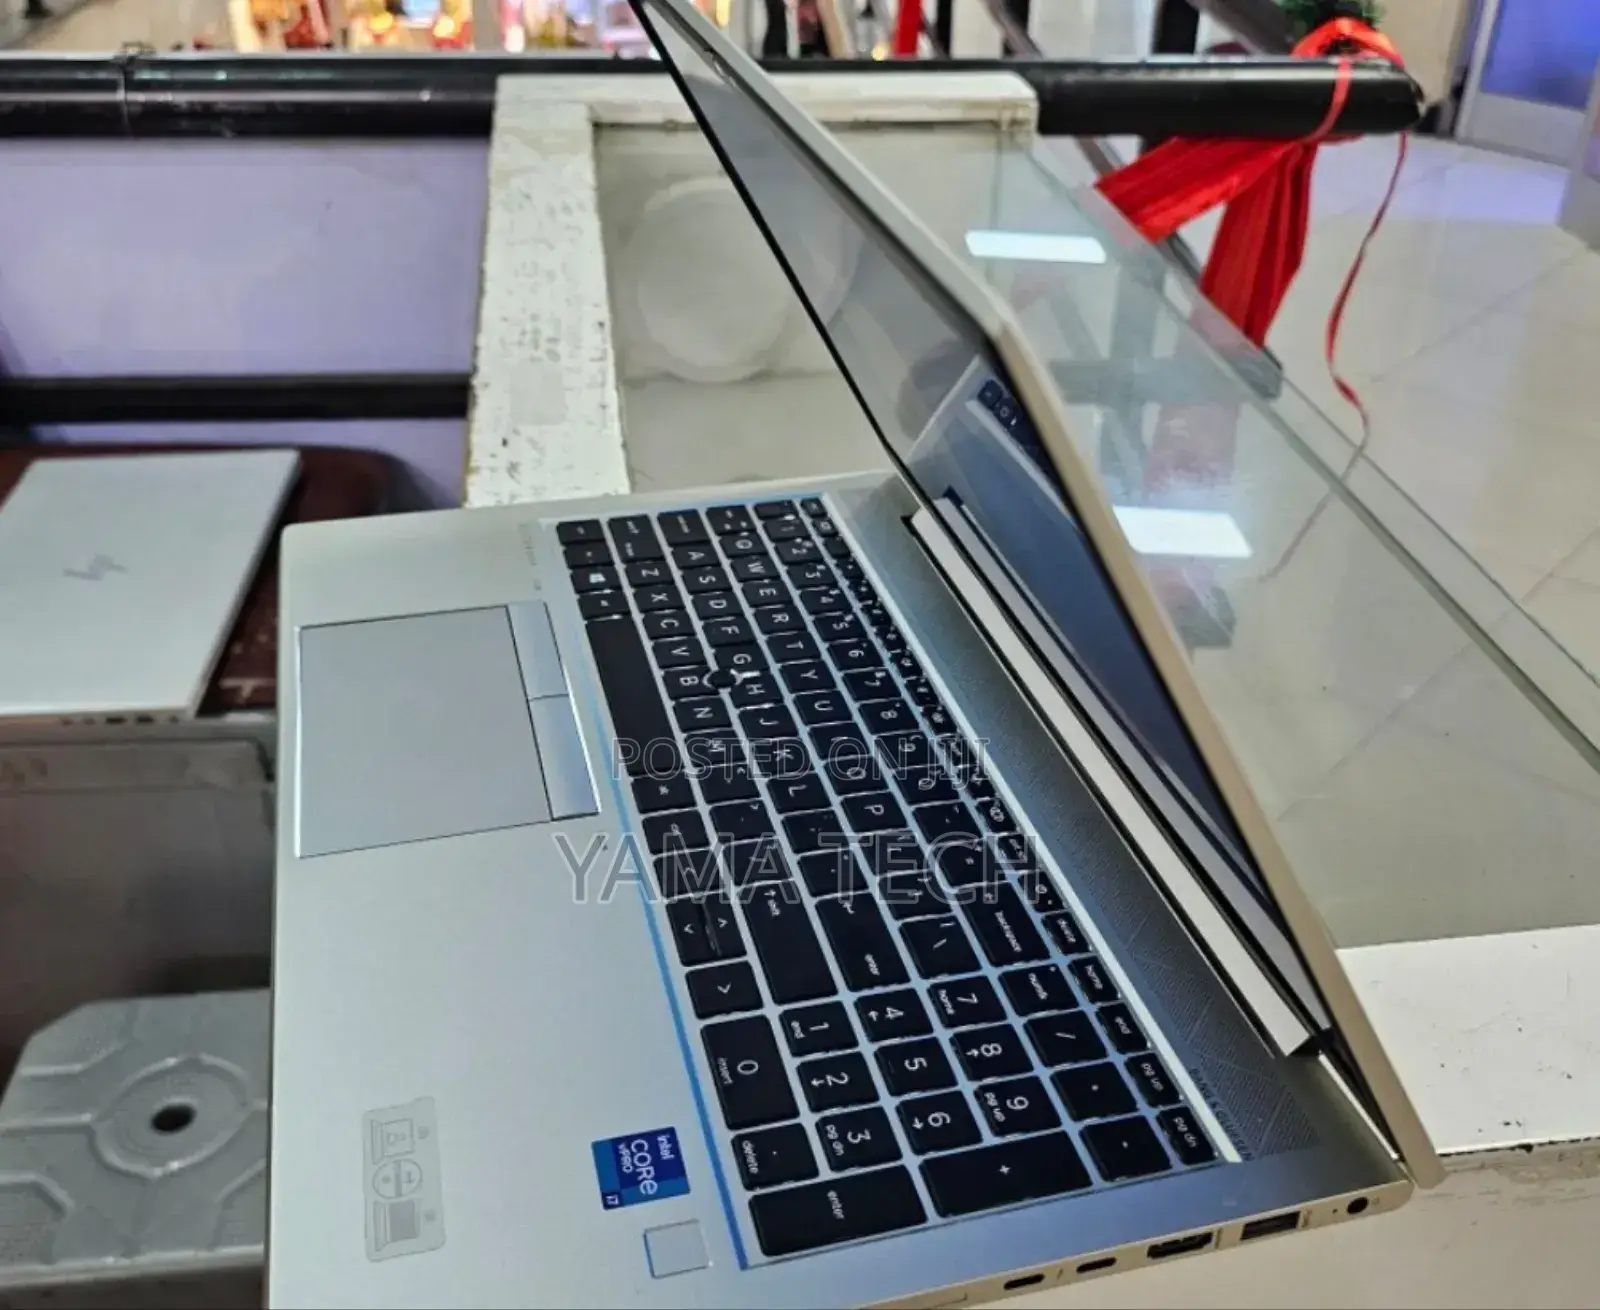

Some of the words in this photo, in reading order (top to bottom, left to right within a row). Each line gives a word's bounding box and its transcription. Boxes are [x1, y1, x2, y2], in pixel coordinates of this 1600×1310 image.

[688, 551, 704, 560] A
[642, 568, 660, 577] Z
[748, 562, 765, 574] W
[700, 575, 716, 584] S
[651, 592, 668, 602] X
[759, 588, 776, 596] E
[708, 599, 726, 608] D
[660, 619, 679, 628] C
[772, 613, 789, 623] R
[721, 625, 740, 634] F
[832, 622, 850, 630] 5
[786, 640, 804, 650] T
[671, 646, 690, 657] V
[848, 649, 864, 658] 6
[733, 653, 751, 664] G
[801, 669, 818, 679] Y
[679, 676, 699, 686] B
[864, 679, 882, 687] 7
[746, 683, 766, 695] H
[814, 700, 834, 711] U
[693, 707, 714, 719] N
[880, 710, 898, 720] 8
[900, 742, 916, 752] 9
[773, 749, 794, 761] K
[846, 767, 866, 780] O
[788, 784, 807, 797] L
[863, 804, 885, 816] P
[956, 993, 978, 1004] 7
[885, 1006, 904, 1021] 4
[809, 1022, 830, 1032] 1
[980, 1042, 1003, 1058] 8
[736, 1059, 759, 1076] 0
[904, 1056, 928, 1072] 5
[826, 1072, 850, 1087] 2
[1006, 1096, 1030, 1111] 9
[927, 1111, 951, 1128] 6
[825, 1124, 840, 1140] pg
[846, 1128, 872, 1145] 3
[656, 1134, 675, 1162] intel
[742, 1140, 760, 1175] delete
[827, 1190, 846, 1221] enter
